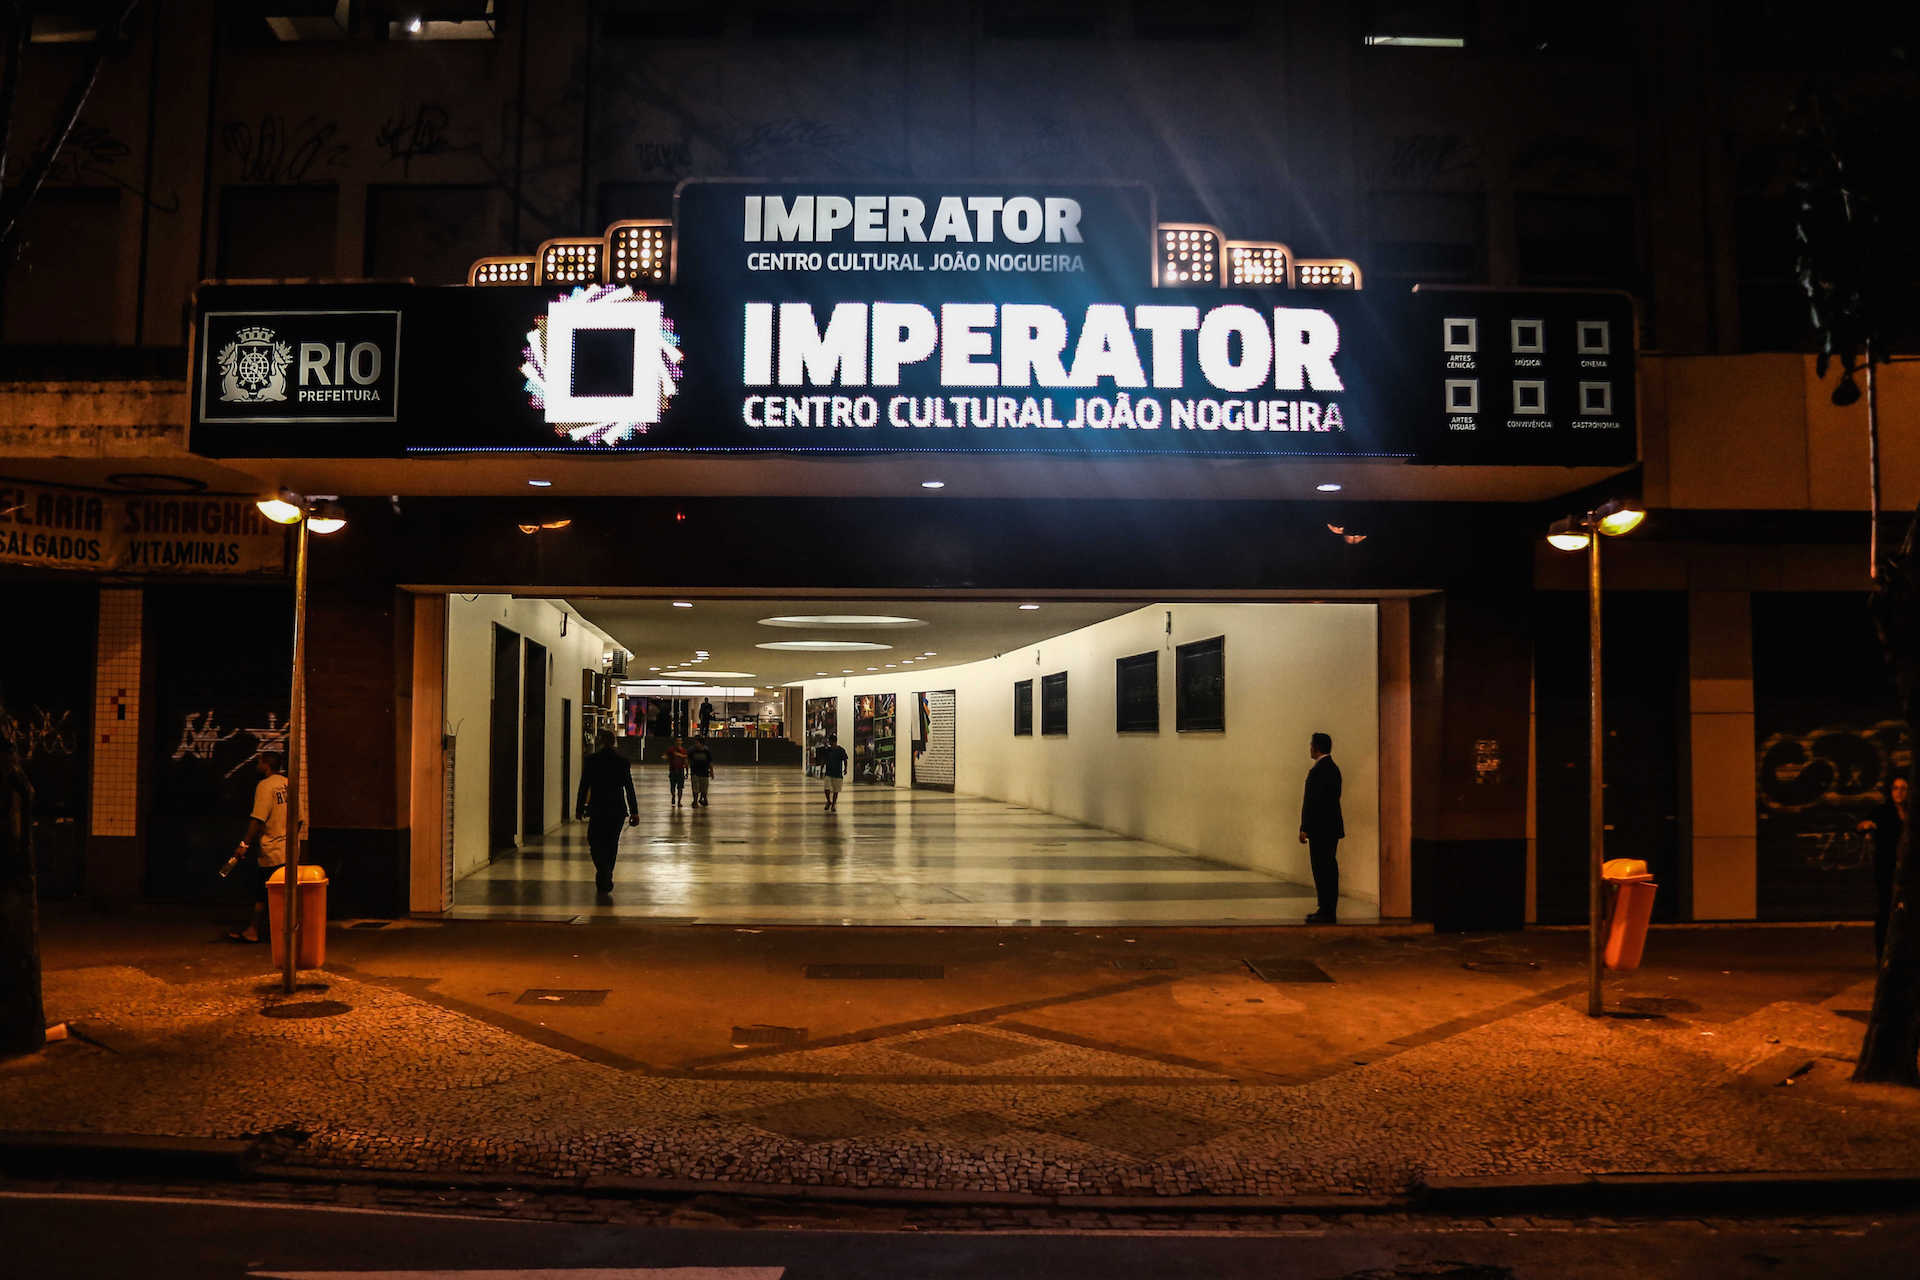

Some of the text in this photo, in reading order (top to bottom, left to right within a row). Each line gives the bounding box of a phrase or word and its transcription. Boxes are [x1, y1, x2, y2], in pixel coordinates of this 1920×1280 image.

[744, 196, 1084, 243] IMPERATOR
[746, 250, 1085, 273] CENTRO CULTURAL JOÃO NOGUEIRA
[744, 302, 1345, 391] IMPERATOR
[299, 342, 382, 386] RIO
[1450, 354, 1472, 362] ARTES
[1514, 357, 1541, 367] MÚSICA
[1580, 360, 1608, 368] CINEMA
[298, 389, 381, 402] PREFEITURA
[743, 391, 1345, 432] CENTRO CULTURAL JOÃO NOGUEIRA
[1451, 416, 1473, 424] ARTES
[1571, 421, 1621, 429] GASTRONOMIA
[1448, 423, 1477, 431] VISUAIS
[129, 541, 240, 565] VITAMINAS
